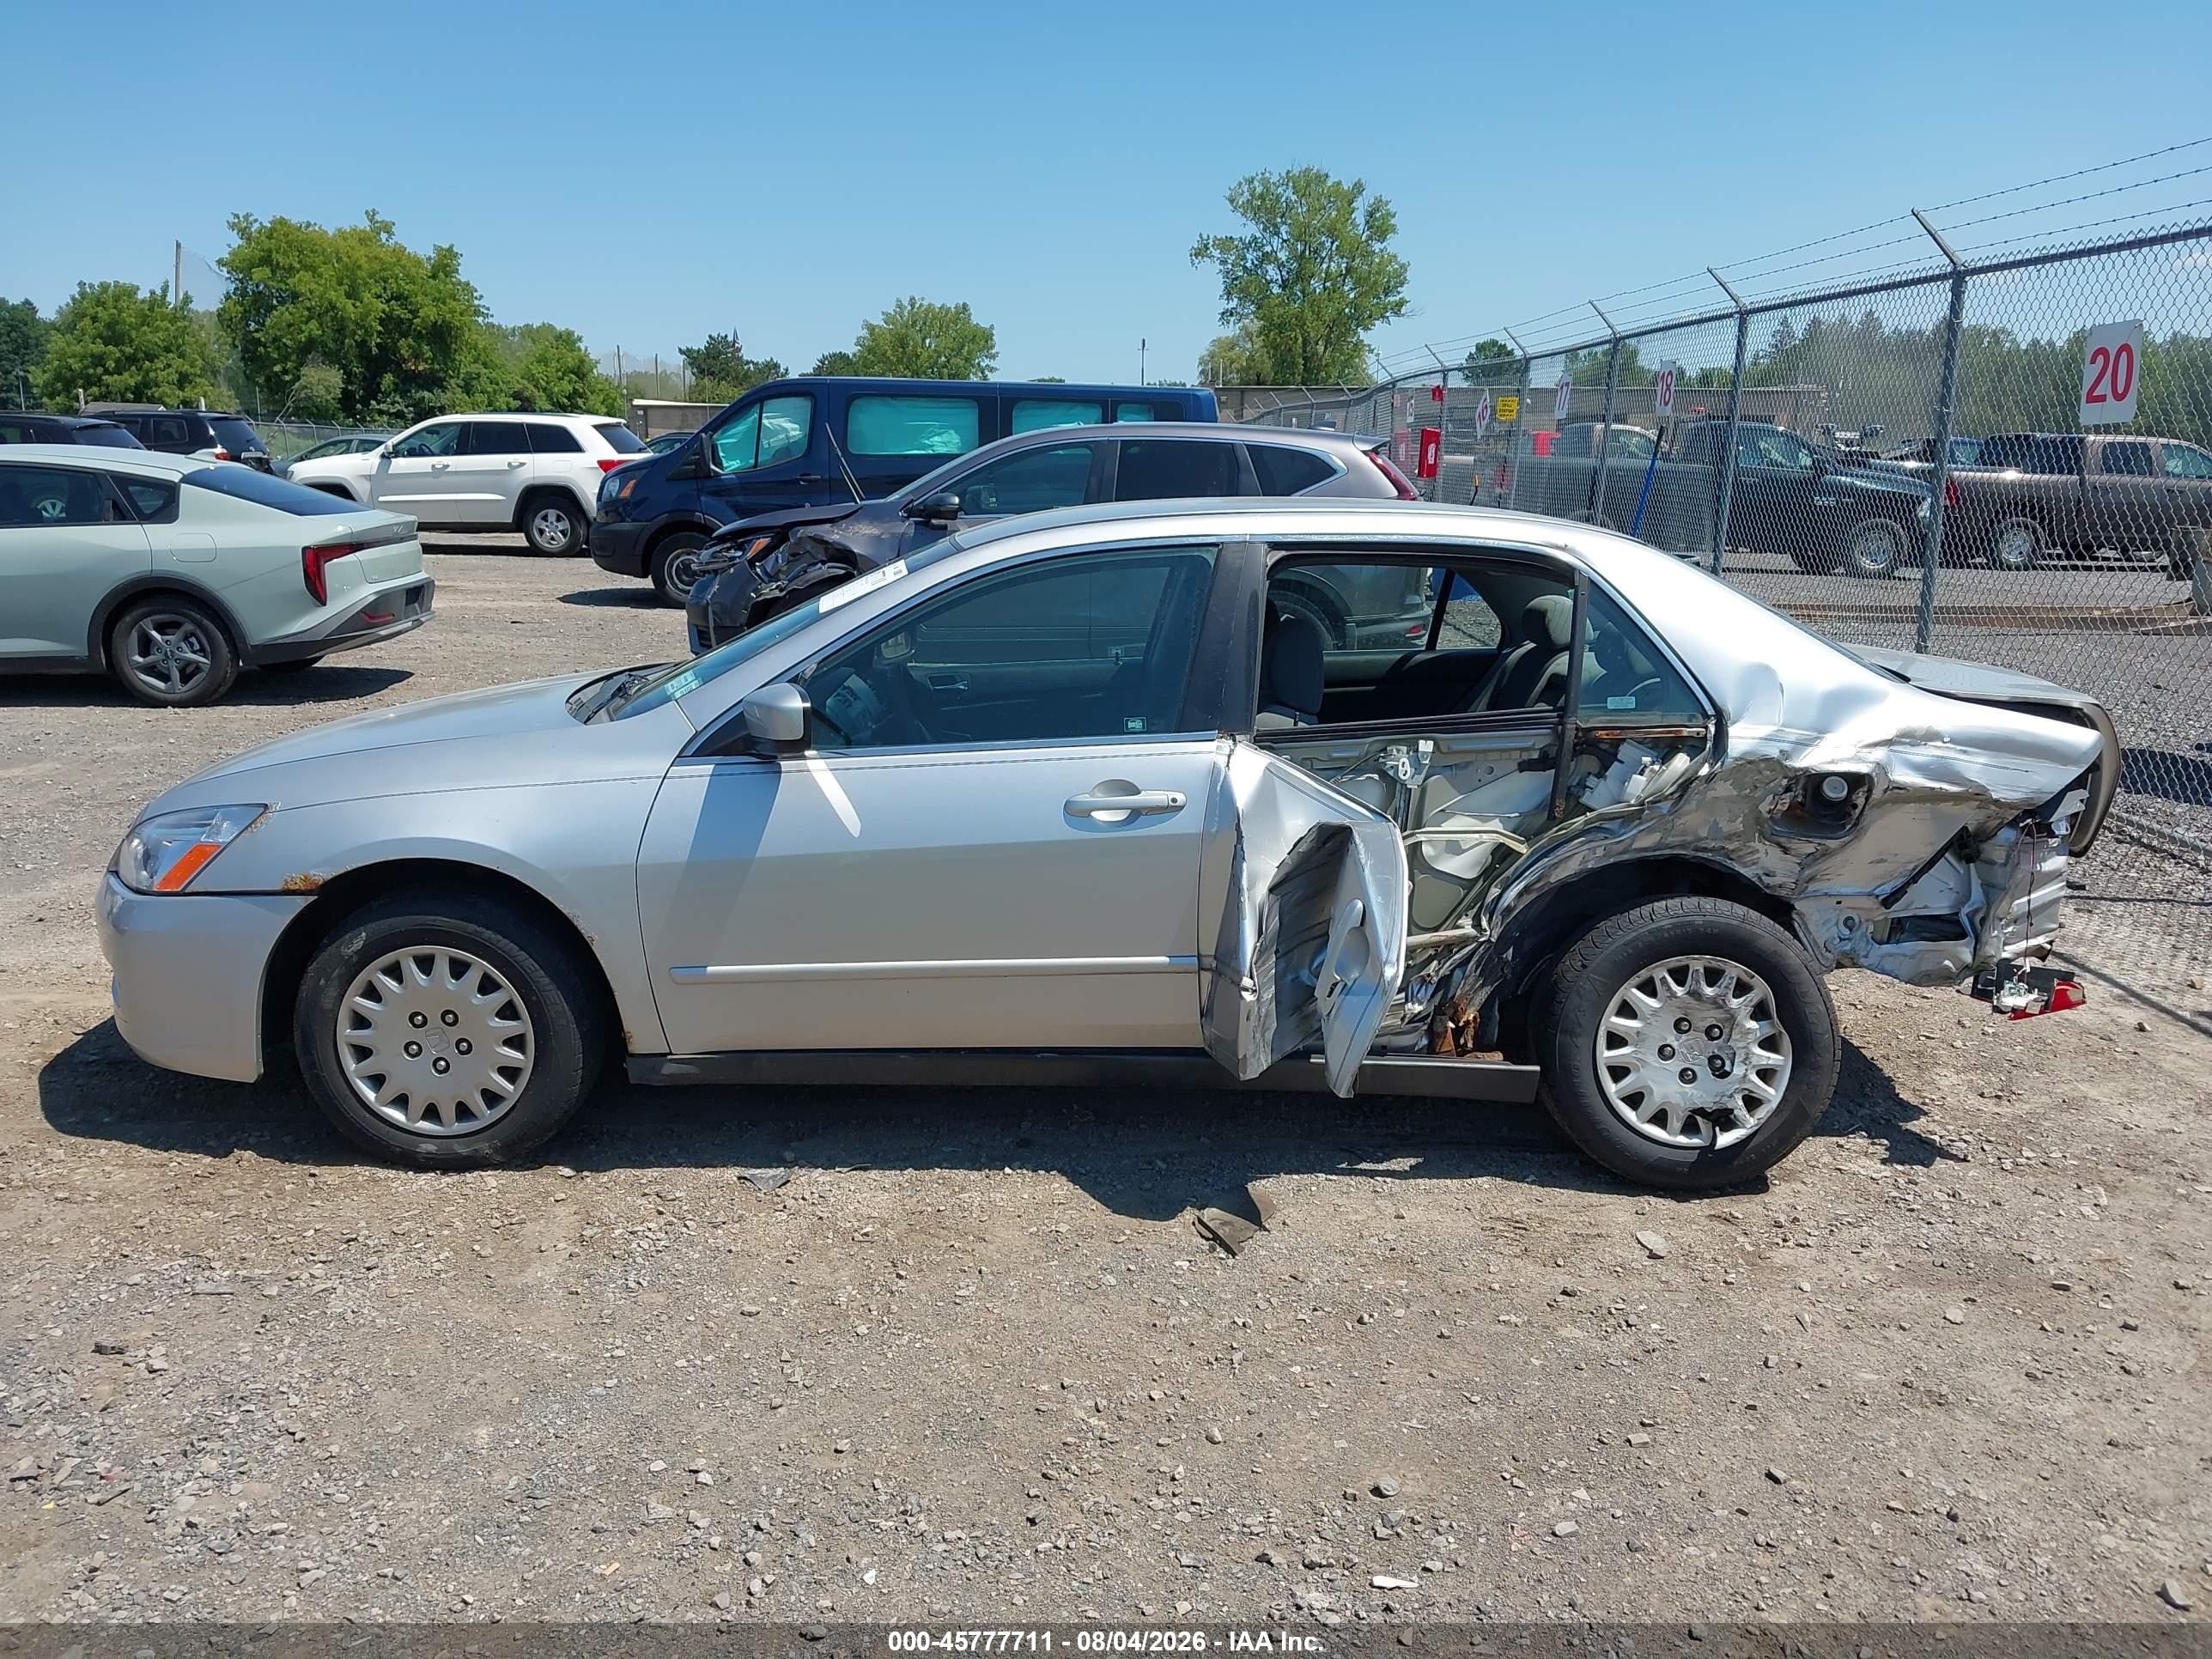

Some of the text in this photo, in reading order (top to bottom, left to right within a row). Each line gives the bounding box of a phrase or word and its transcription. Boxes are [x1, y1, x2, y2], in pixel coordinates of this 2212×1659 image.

[1659, 370, 1674, 407] 18
[2086, 343, 2134, 404] 20
[1558, 381, 1570, 411] 17
[1477, 398, 1488, 428] 16
